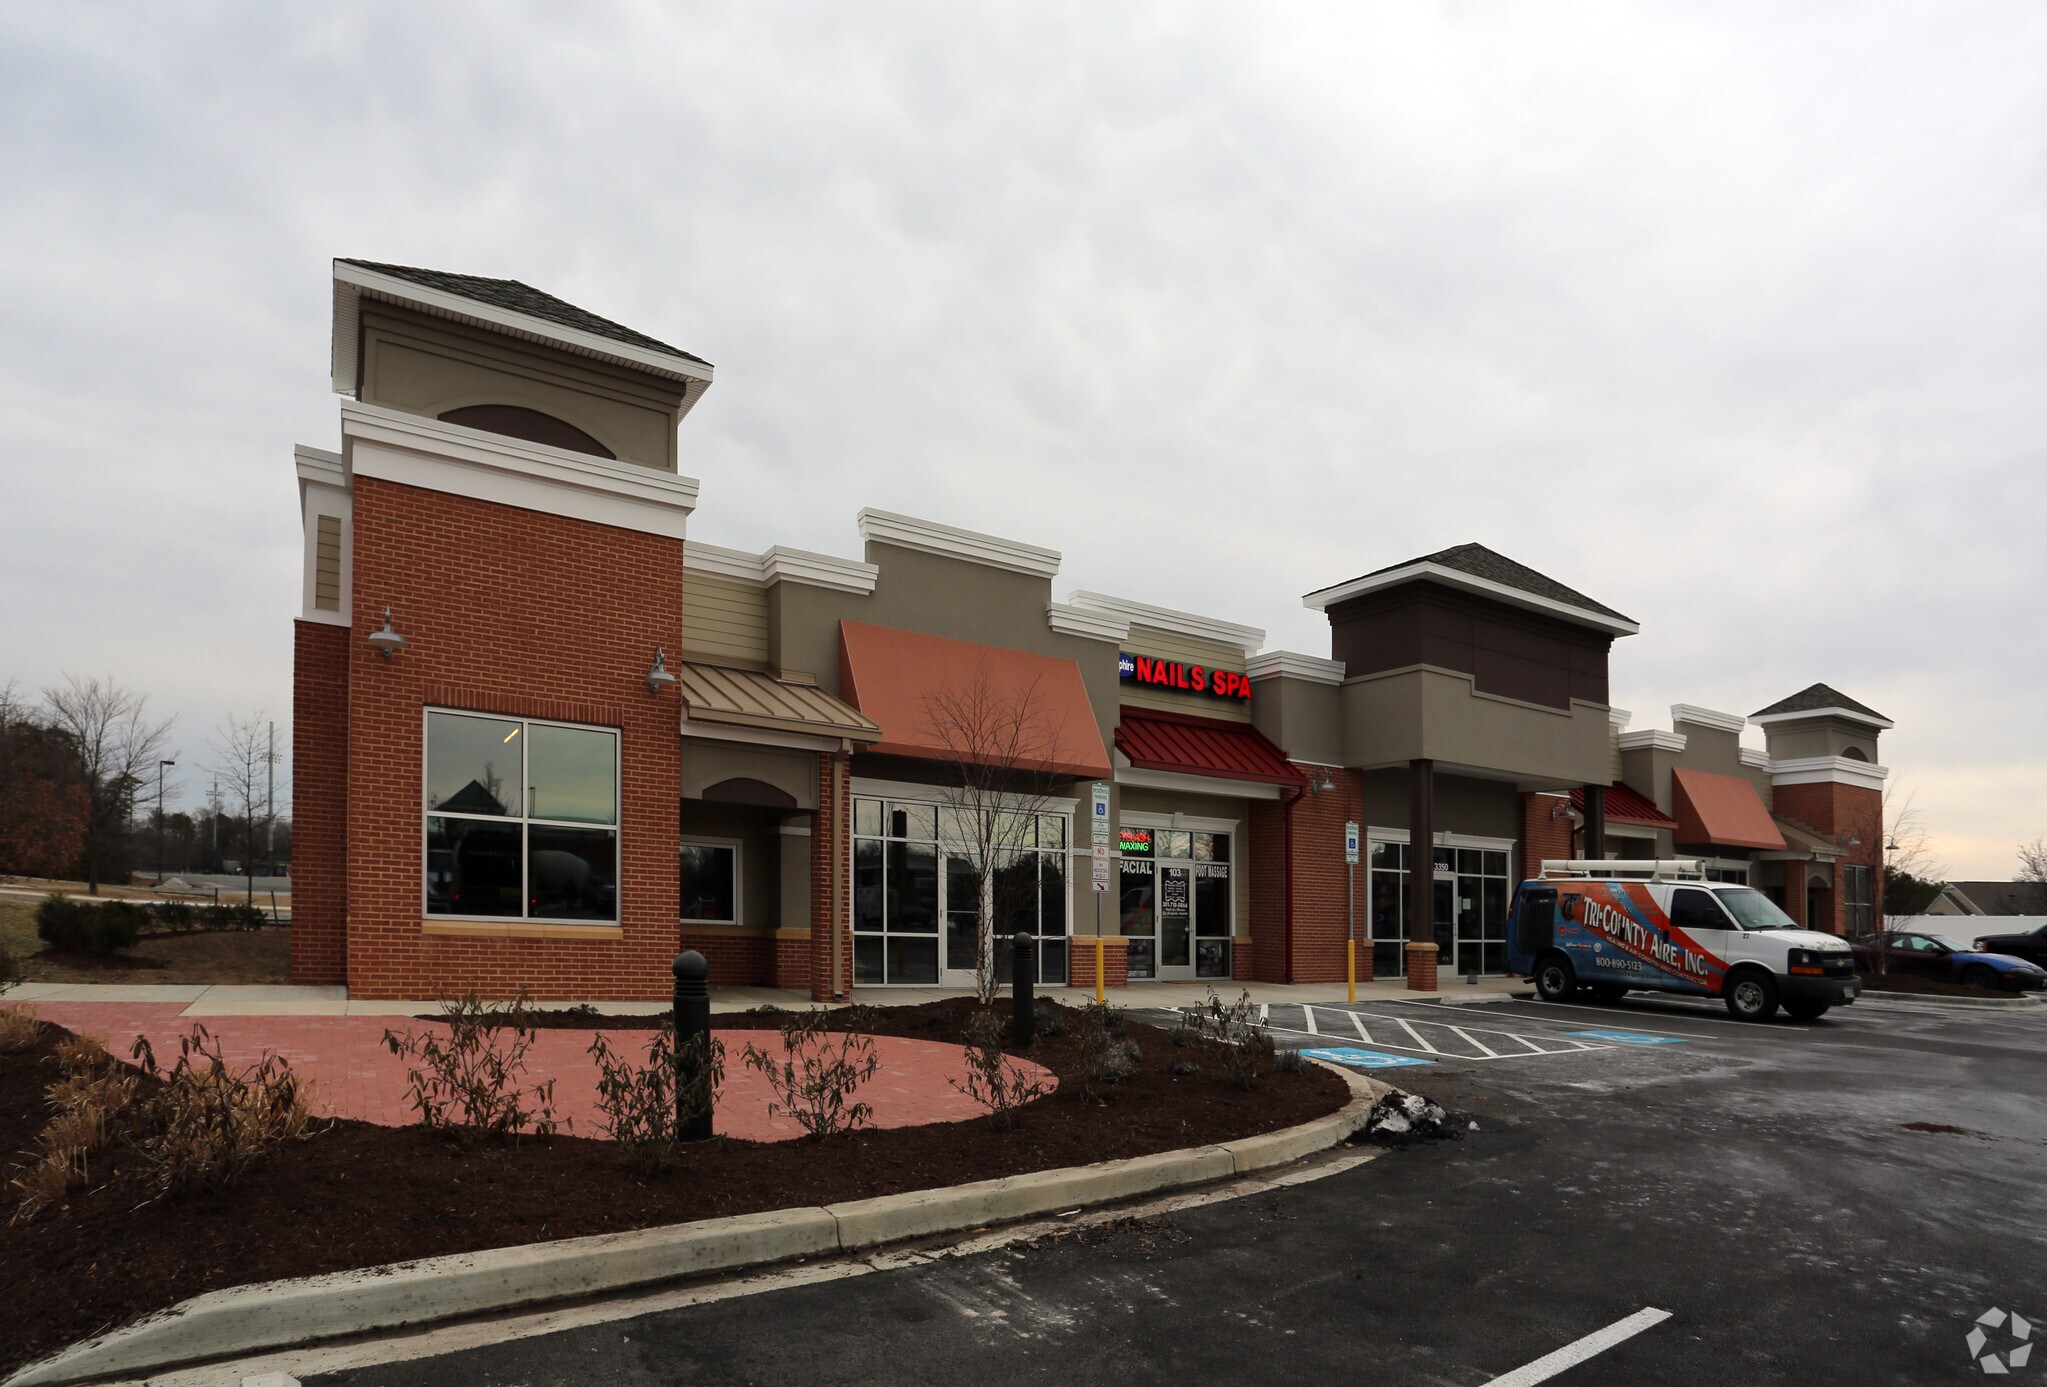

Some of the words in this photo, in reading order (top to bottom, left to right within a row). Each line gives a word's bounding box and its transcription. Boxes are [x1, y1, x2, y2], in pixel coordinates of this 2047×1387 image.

[1136, 656, 1206, 691] NAILS
[1213, 669, 1252, 699] SPA
[1097, 847, 1105, 855] NO
[1434, 862, 1449, 871] 3350
[1168, 868, 1182, 877] 103
[1583, 896, 1648, 951] TRI-COUNTY
[1650, 933, 1681, 970] AIRE,
[1684, 948, 1709, 976] INC.
[1595, 957, 1642, 970] 800-890-5123
